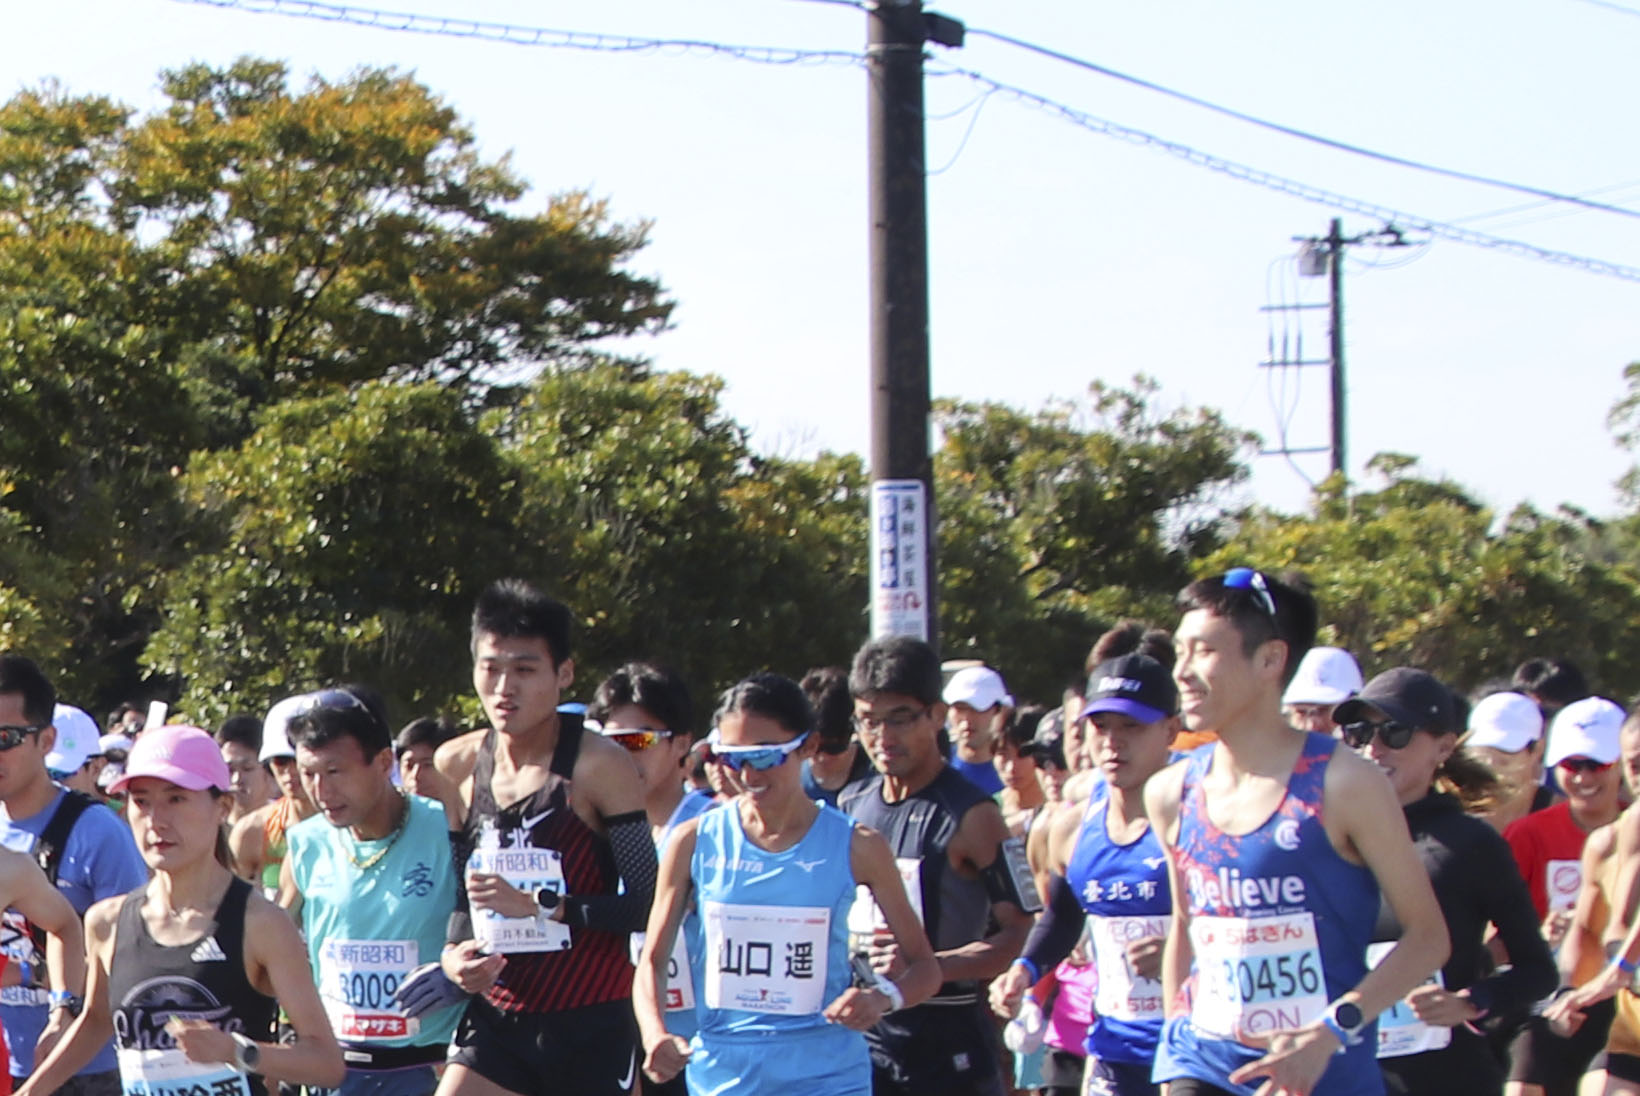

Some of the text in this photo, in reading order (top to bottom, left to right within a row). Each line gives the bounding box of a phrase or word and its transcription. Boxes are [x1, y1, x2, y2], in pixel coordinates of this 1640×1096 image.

[1187, 866, 1306, 909] Believe
[340, 944, 405, 964] 新昭和
[718, 937, 772, 977] 山口
[785, 940, 814, 979] 遥
[339, 973, 408, 1010] 3009
[1223, 952, 1319, 1003] 30456
